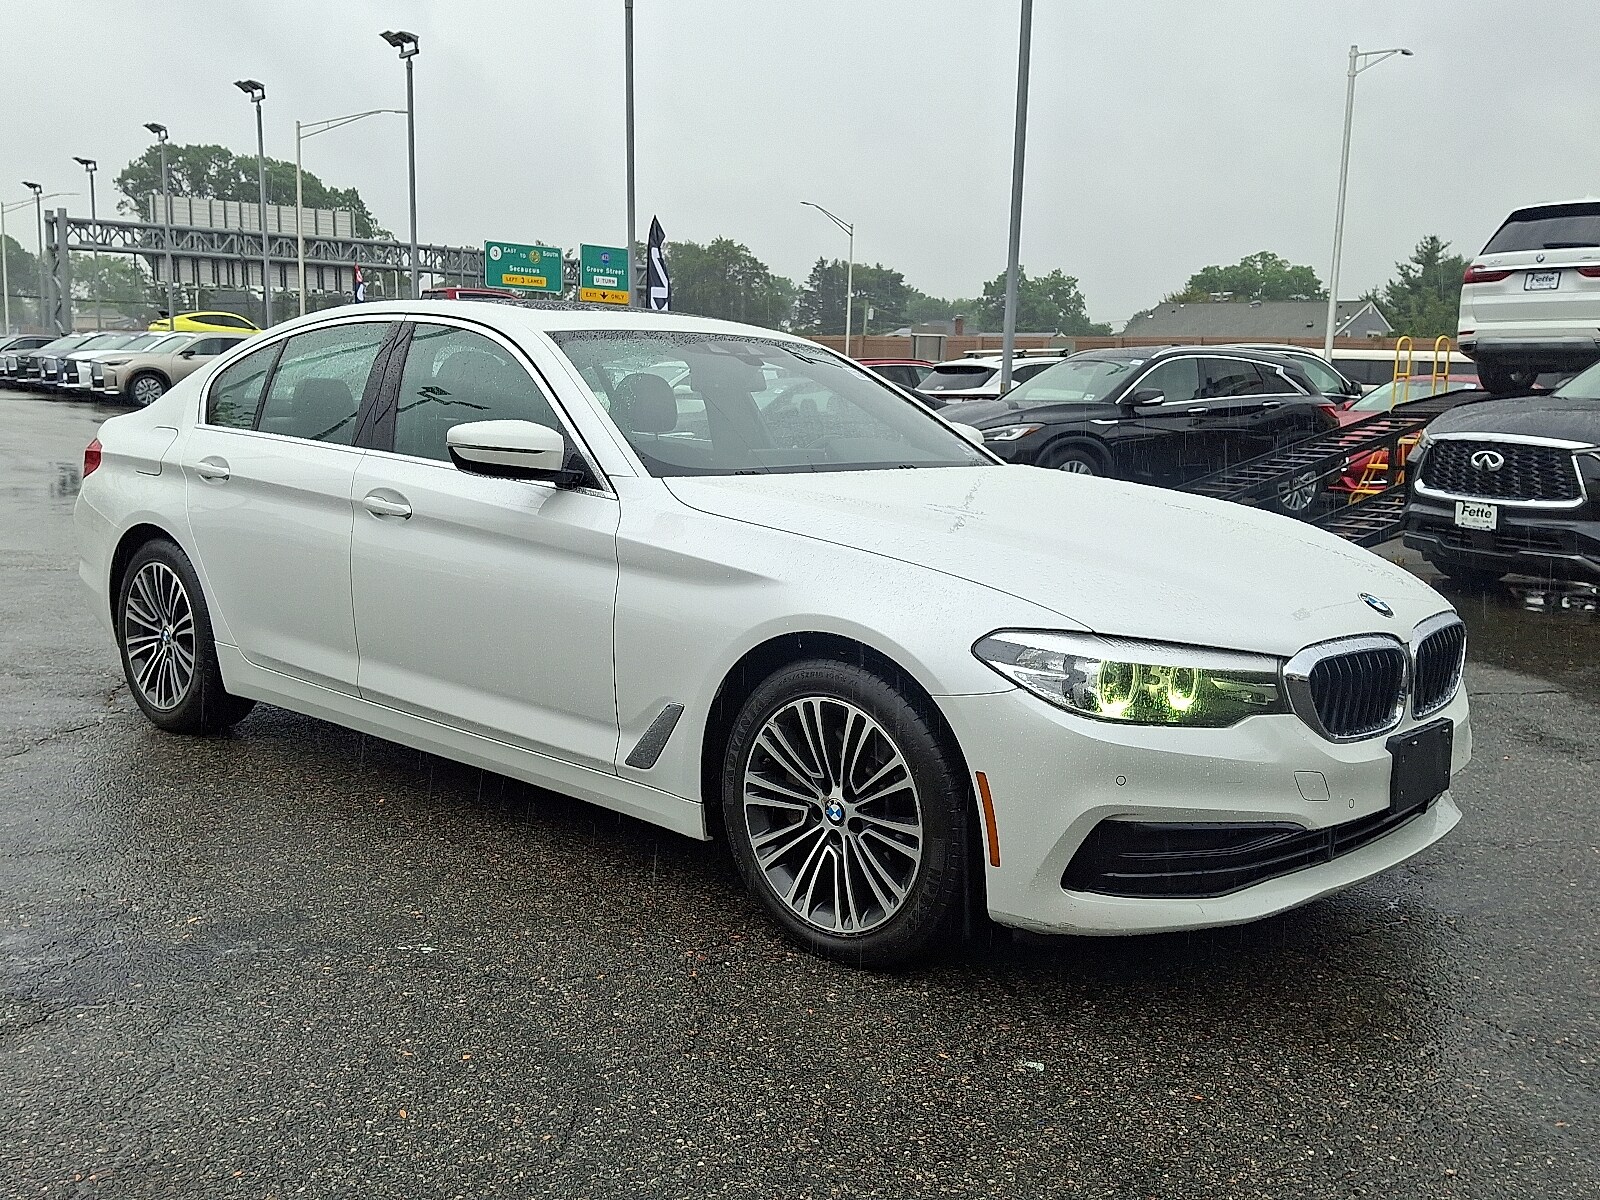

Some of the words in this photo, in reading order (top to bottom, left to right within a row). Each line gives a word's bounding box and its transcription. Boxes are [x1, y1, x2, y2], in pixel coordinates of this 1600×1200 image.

[503, 246, 517, 254] EAST
[542, 250, 559, 258] SOUTH
[509, 264, 540, 274] Secaucus
[586, 265, 604, 274] Grove
[605, 267, 625, 276] Street
[1461, 505, 1492, 519] Fette
